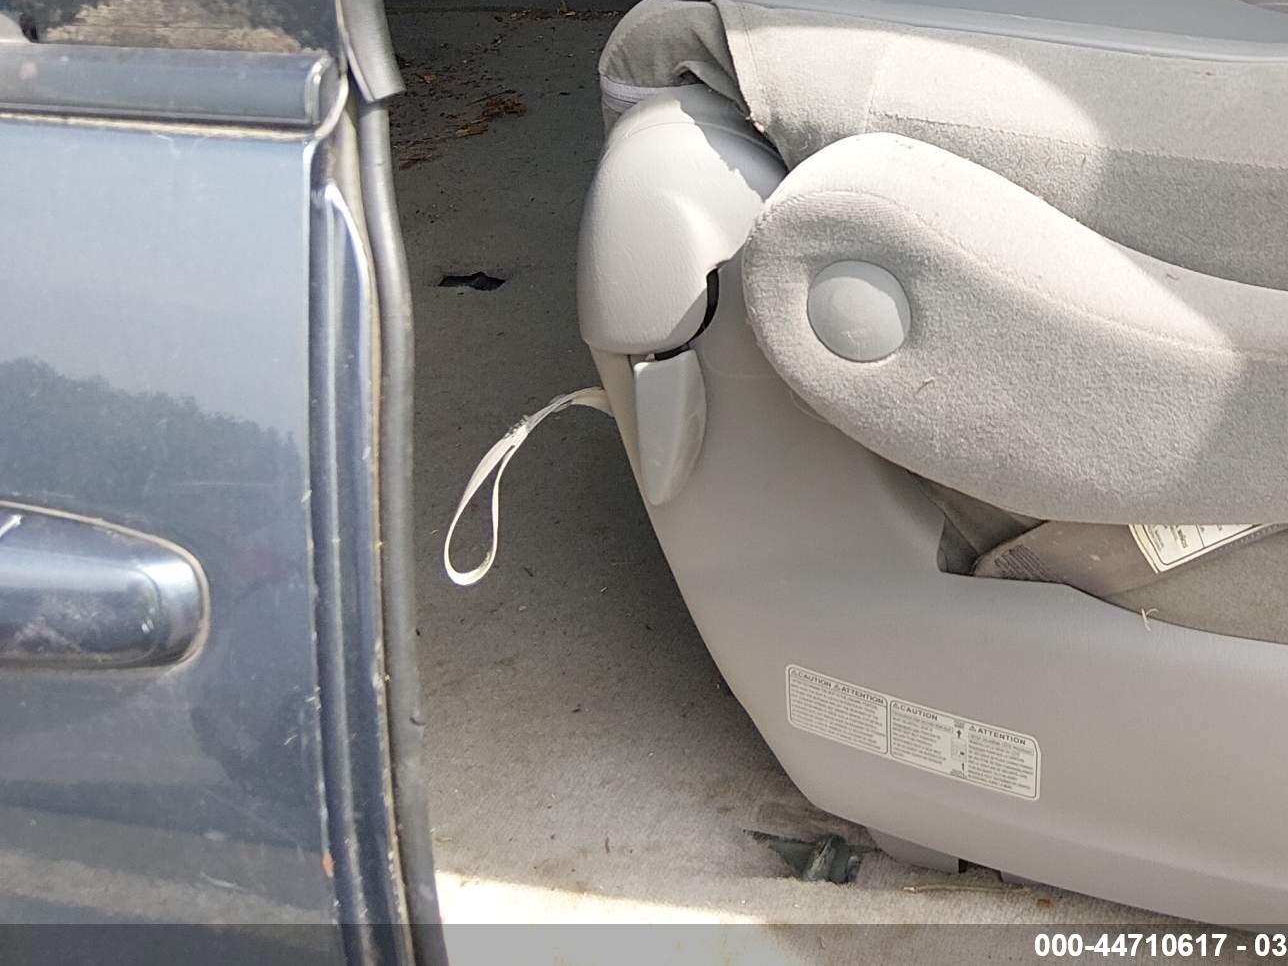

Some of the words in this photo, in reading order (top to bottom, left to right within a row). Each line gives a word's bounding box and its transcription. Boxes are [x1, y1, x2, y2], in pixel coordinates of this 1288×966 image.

[798, 671, 832, 687] CAUTION
[841, 686, 884, 704] ATTENTION
[900, 704, 938, 721] CAUTION
[977, 728, 1026, 745] ATTENTION
